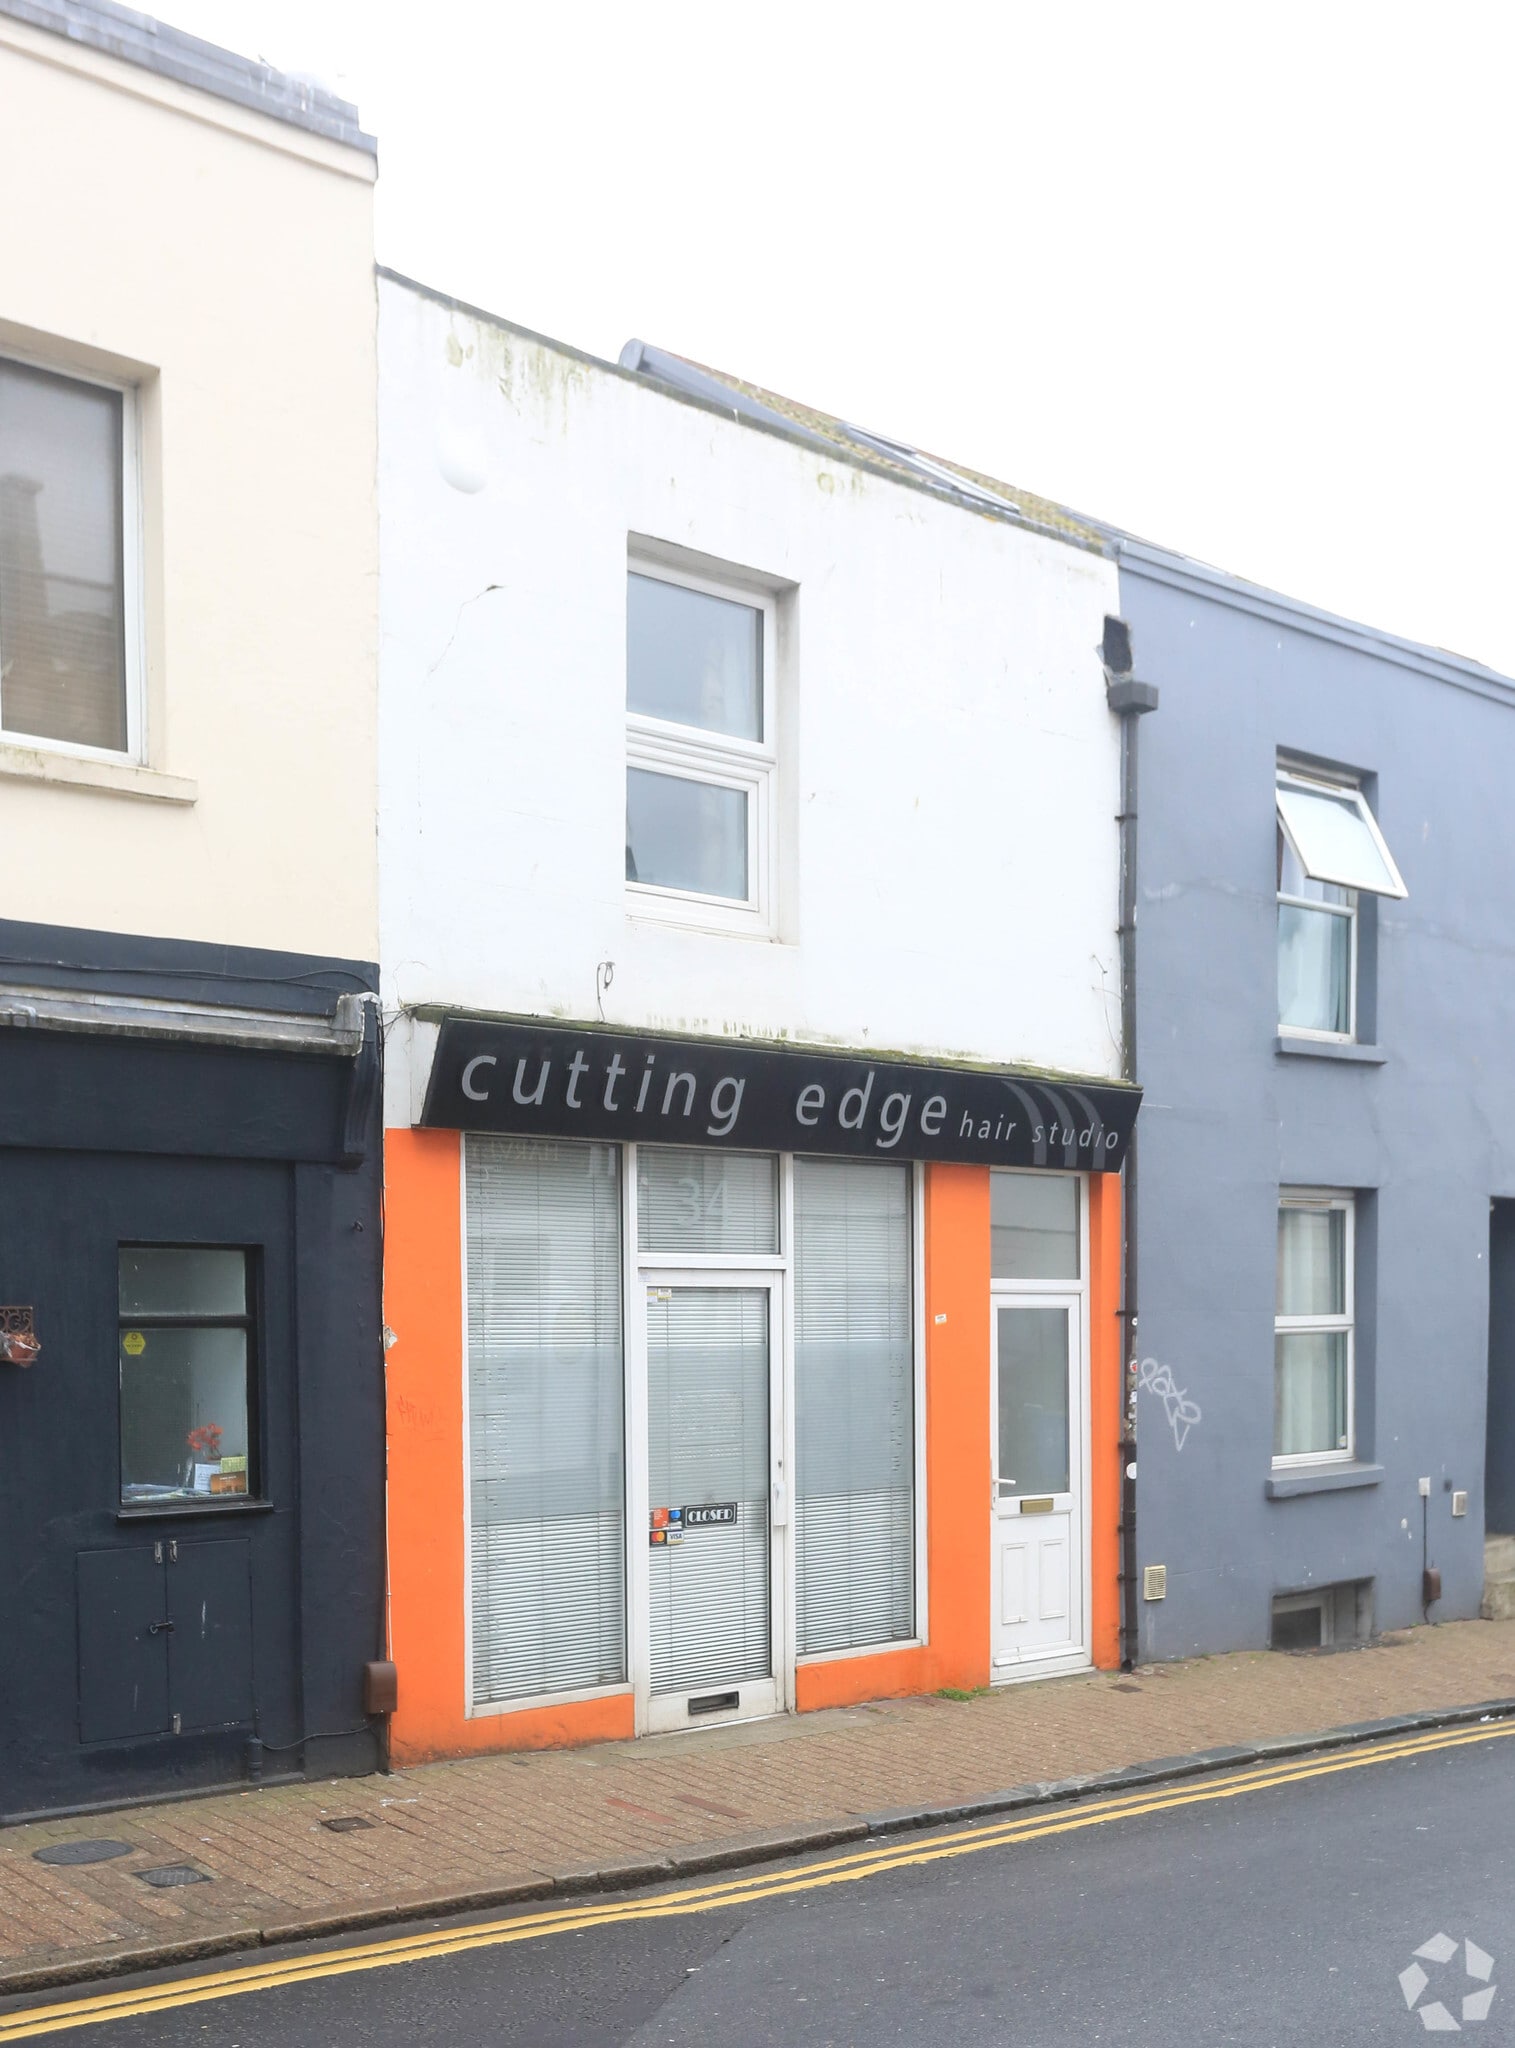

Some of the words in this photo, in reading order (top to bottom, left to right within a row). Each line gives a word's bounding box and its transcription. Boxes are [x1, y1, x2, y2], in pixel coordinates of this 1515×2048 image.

[461, 1049, 746, 1137] cutting
[795, 1070, 948, 1149] edge
[958, 1109, 1017, 1141] hair
[1031, 1119, 1119, 1150] studio
[677, 1177, 733, 1229] 34
[688, 1508, 733, 1523] CLOSED
